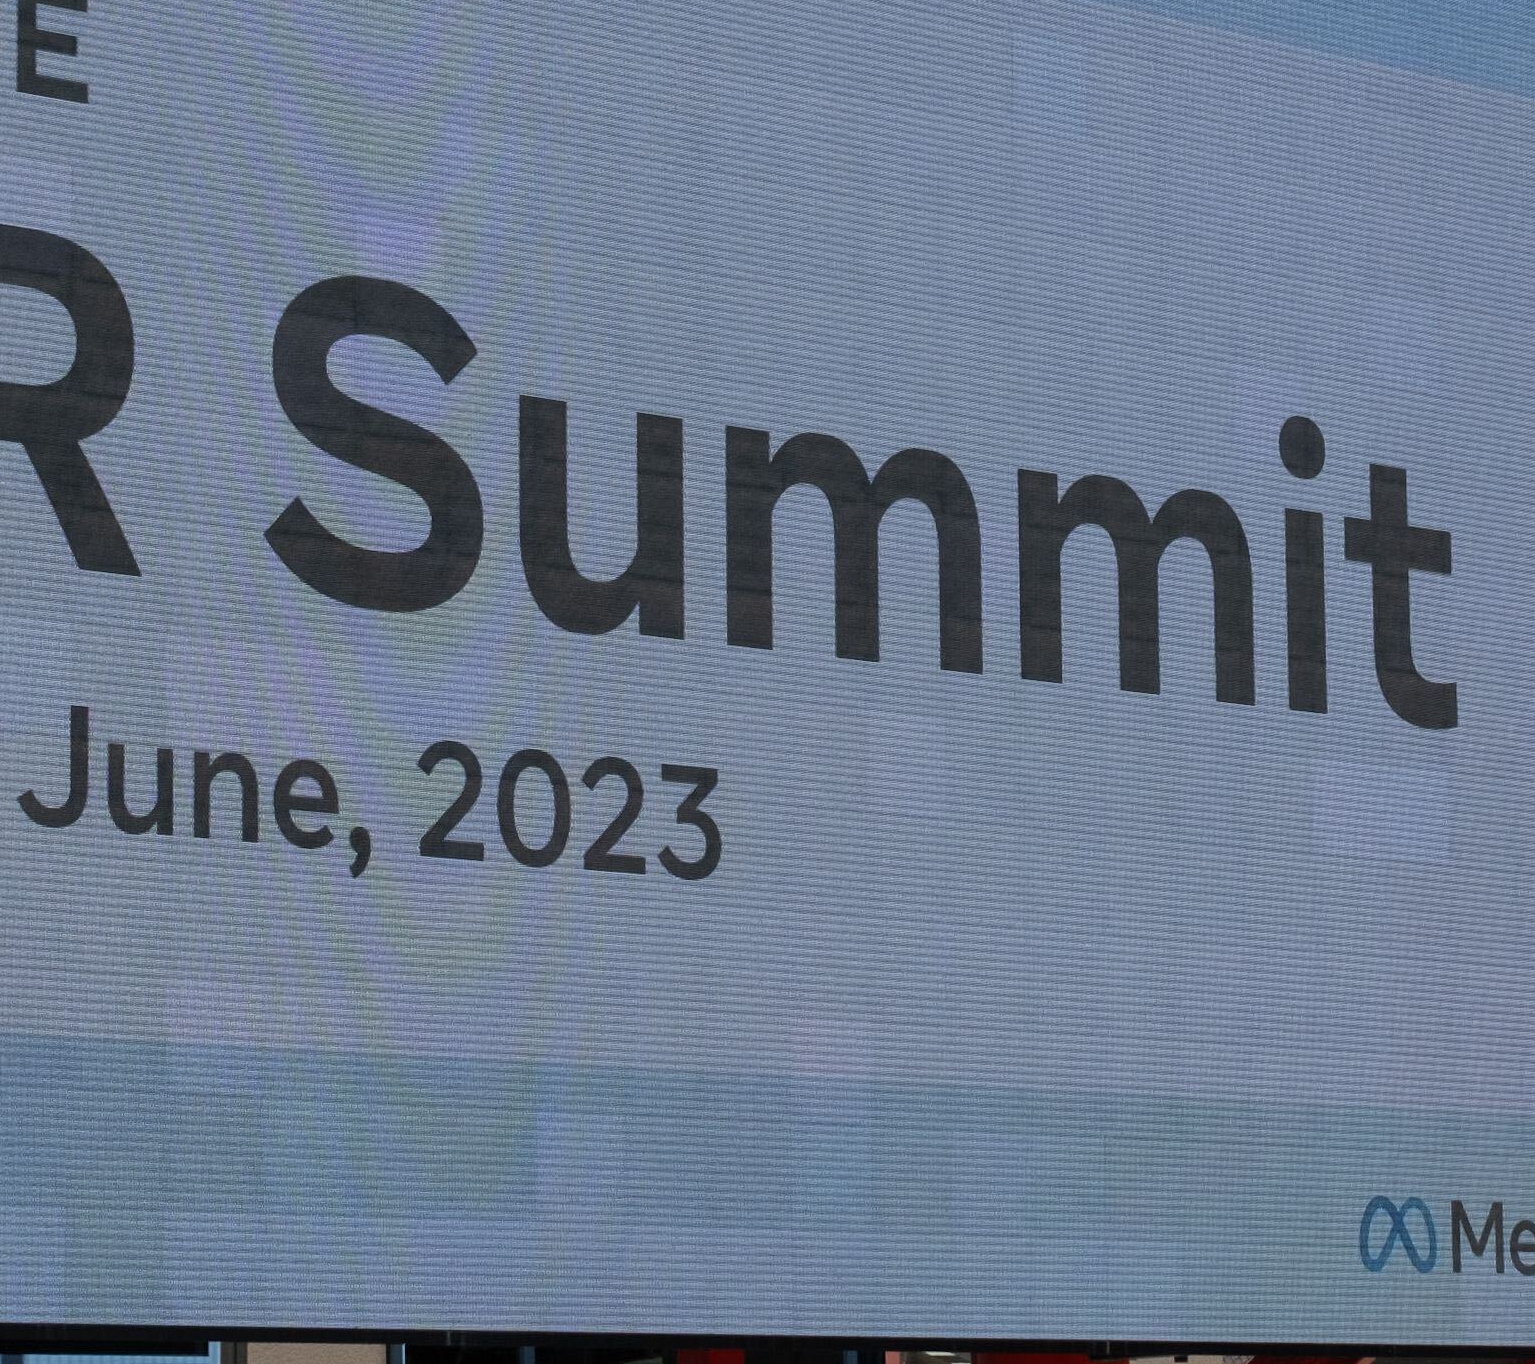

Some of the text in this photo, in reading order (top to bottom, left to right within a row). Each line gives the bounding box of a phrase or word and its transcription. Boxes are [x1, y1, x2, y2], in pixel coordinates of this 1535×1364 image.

[262, 273, 1460, 731] Summit
[16, 704, 374, 881] June,
[414, 738, 724, 881] 2023
